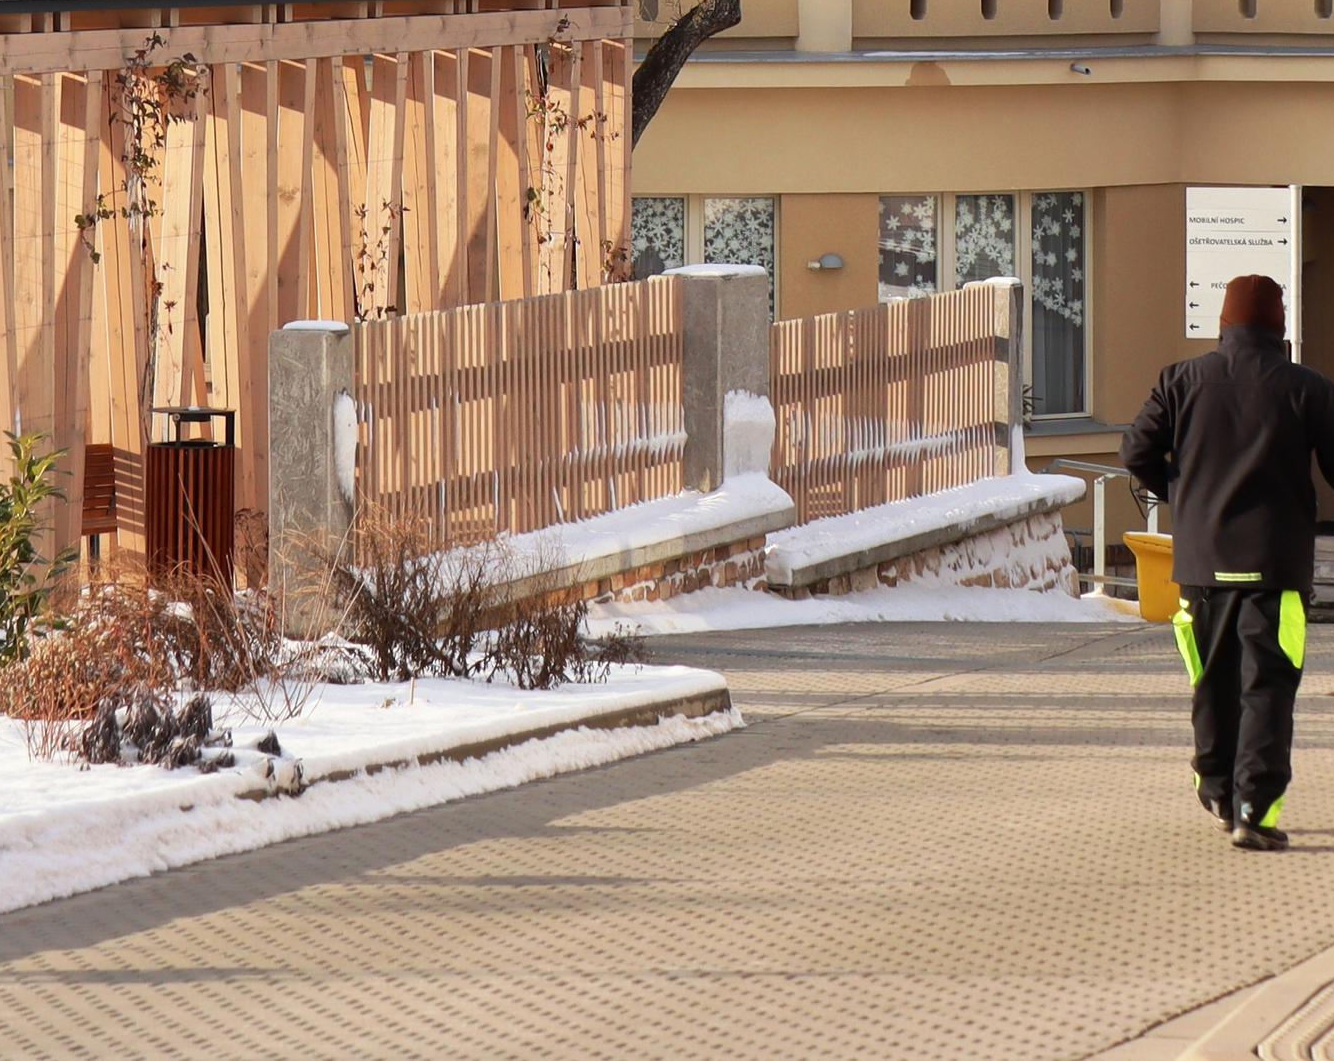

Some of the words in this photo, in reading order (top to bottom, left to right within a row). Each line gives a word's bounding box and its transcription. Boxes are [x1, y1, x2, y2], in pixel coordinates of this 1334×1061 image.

[1189, 216, 1218, 224] MOBILNÍ
[1220, 217, 1245, 225] HOSPIC
[1189, 237, 1247, 246] OŠETŘOVATELSKÁ
[1248, 238, 1273, 246] SLUŽBA
